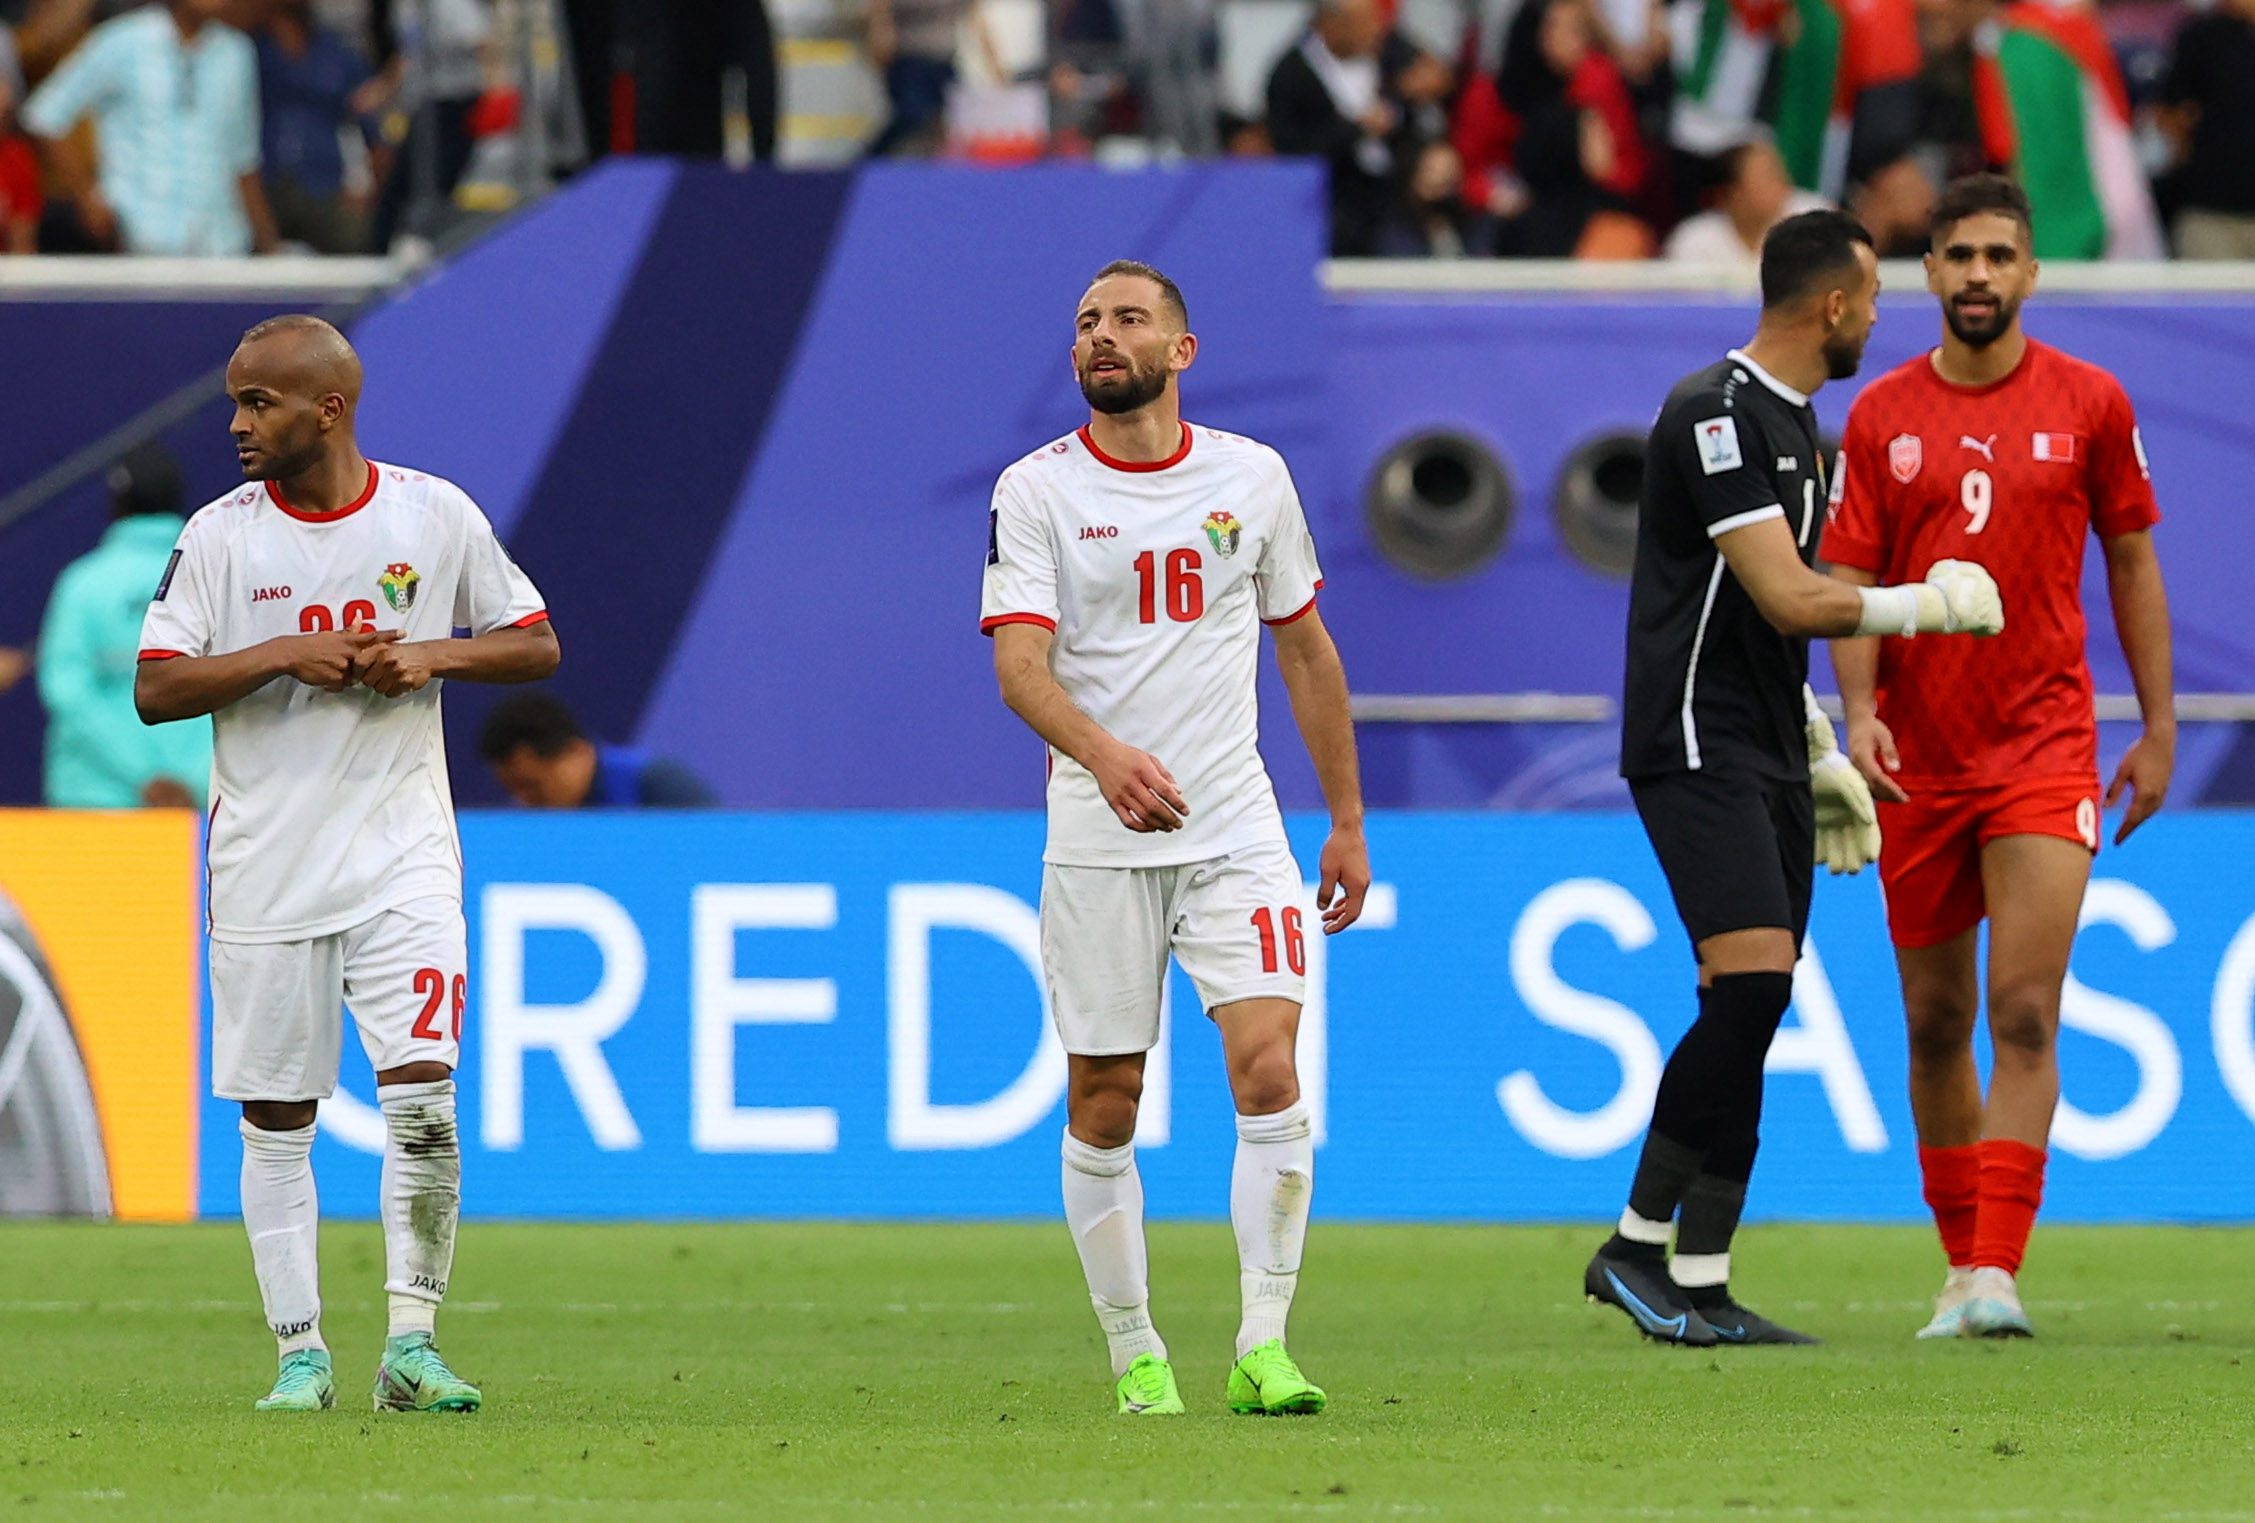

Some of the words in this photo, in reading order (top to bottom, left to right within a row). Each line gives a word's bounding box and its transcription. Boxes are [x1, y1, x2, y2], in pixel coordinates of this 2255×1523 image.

[1960, 468, 1992, 535] 9
[1078, 525, 1119, 541] JAKO
[251, 585, 292, 603] JAKO
[1133, 547, 1204, 625] 16
[2075, 797, 2097, 849] 9
[1250, 905, 1306, 977] 16
[317, 880, 1400, 1157] RED
[411, 967, 466, 1041] 26
[409, 1273, 446, 1296] JAKO
[1255, 1280, 1291, 1300] JAKO
